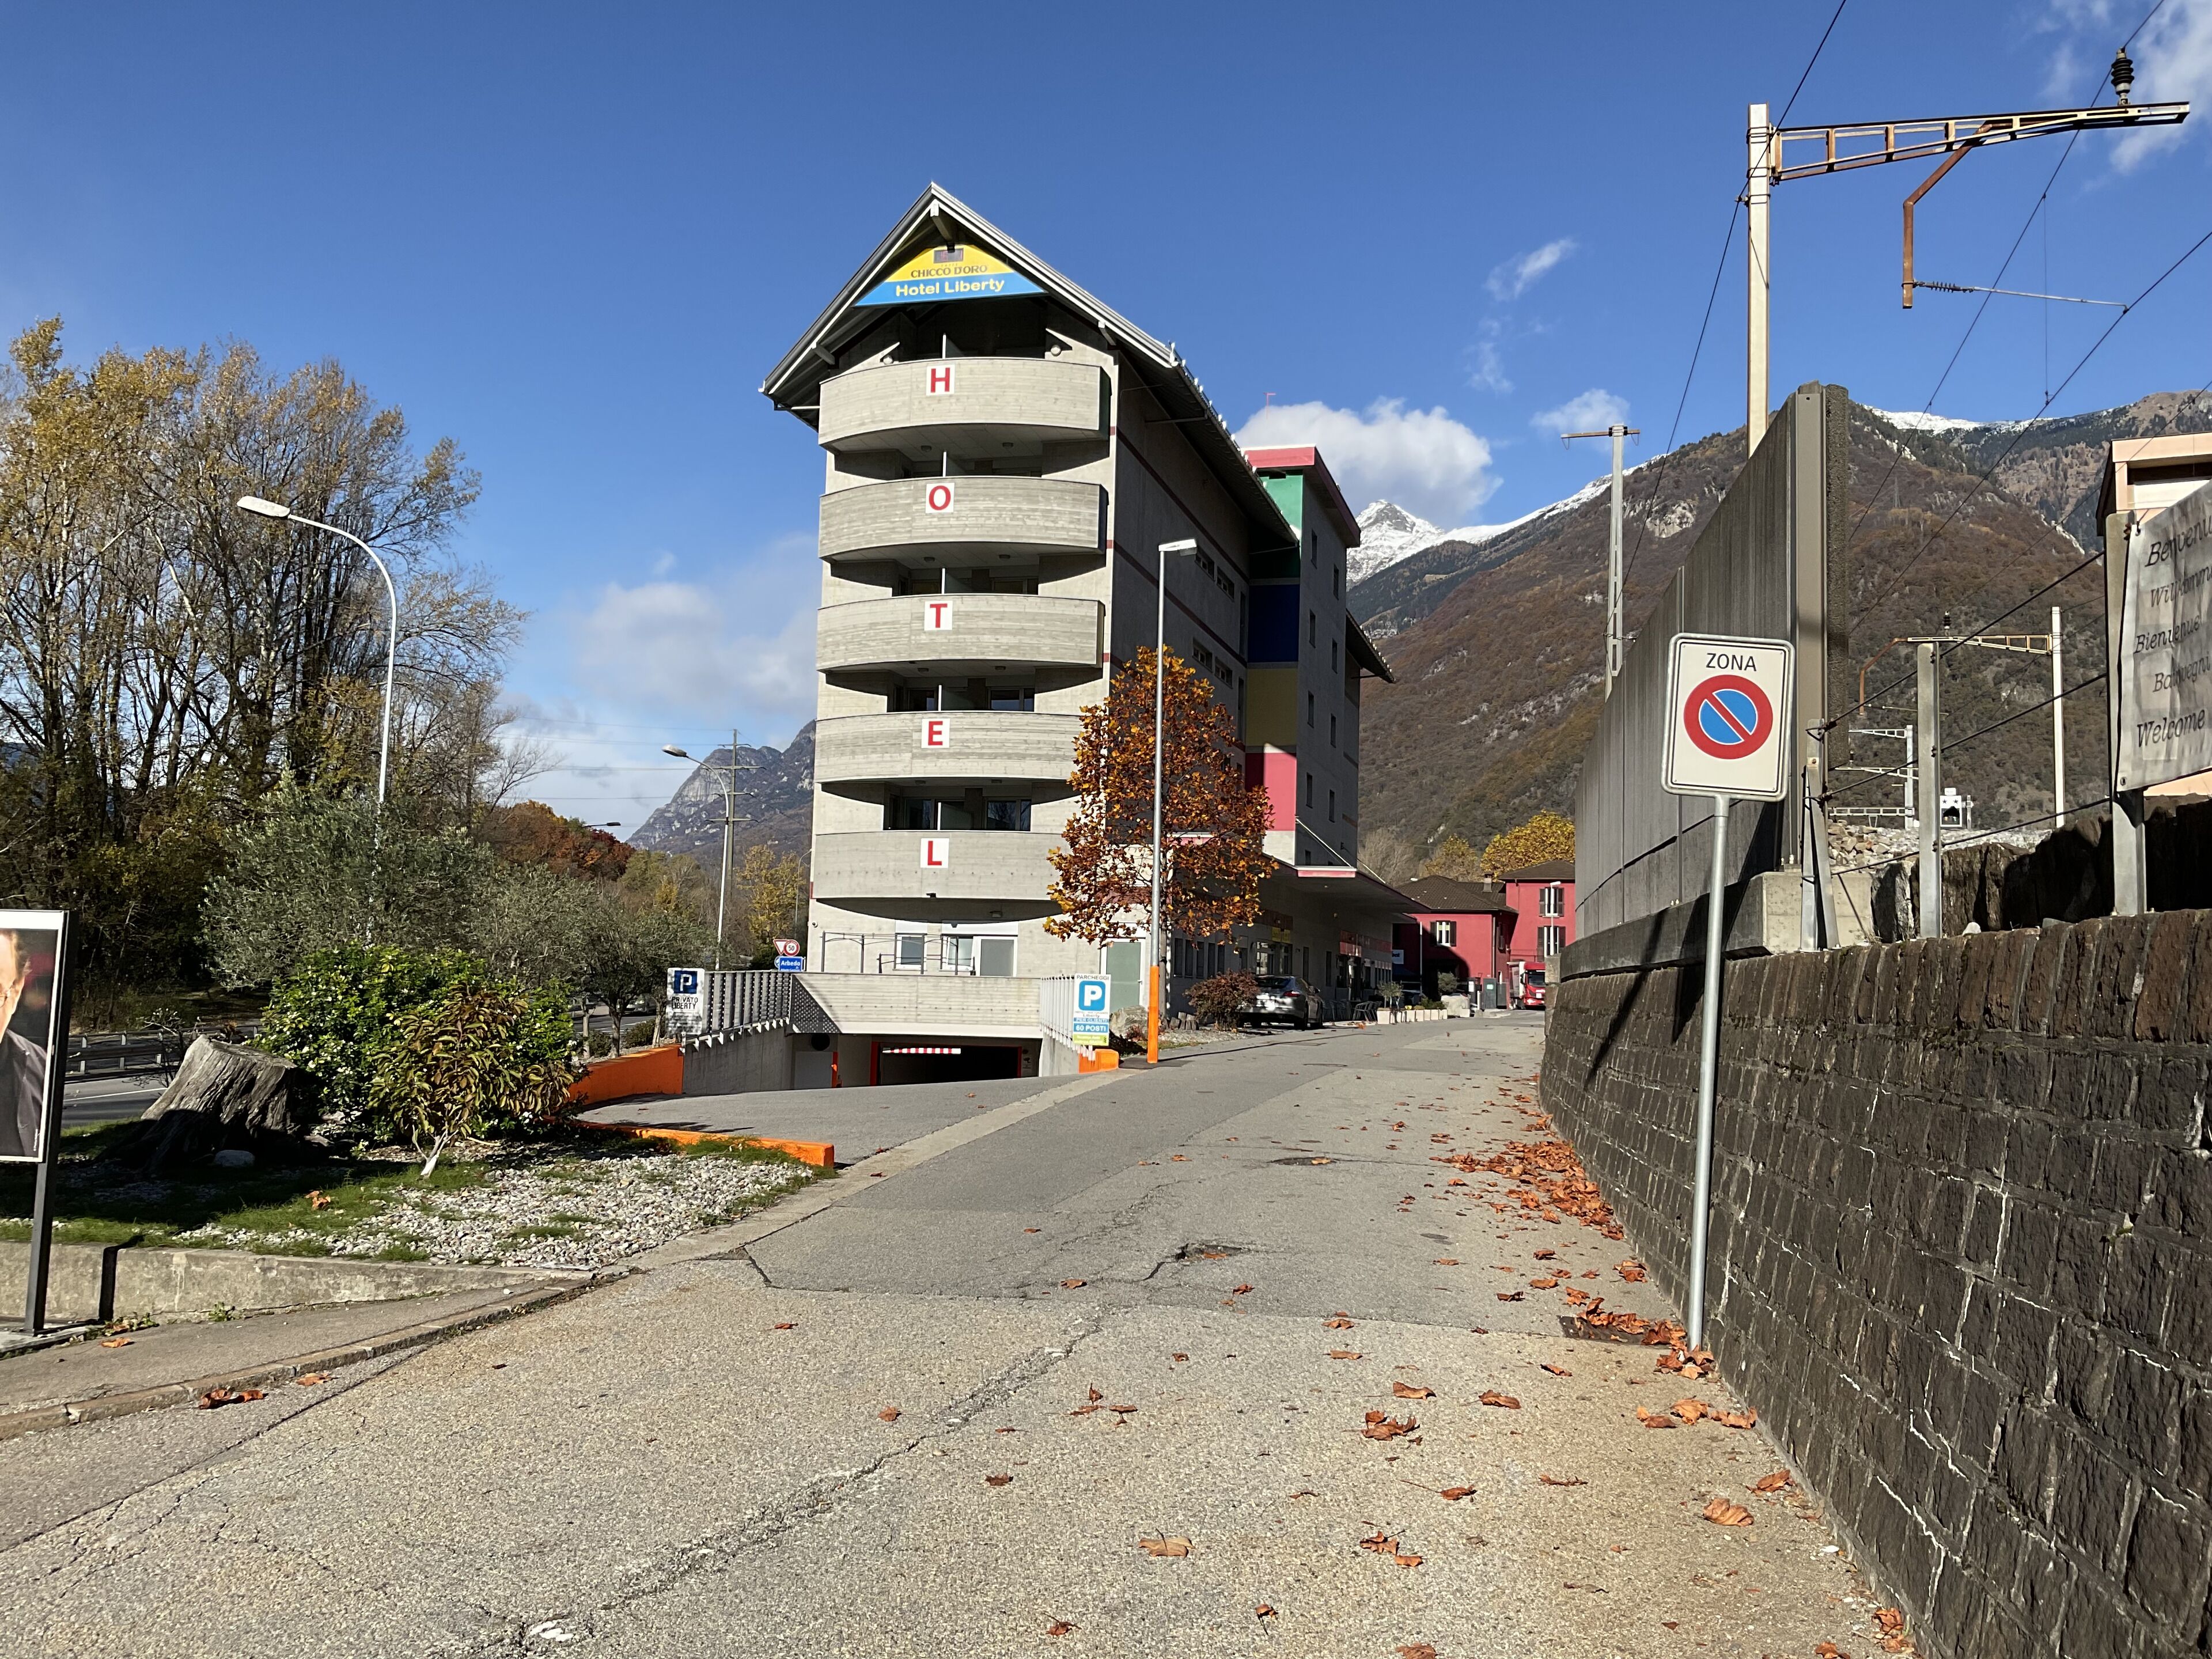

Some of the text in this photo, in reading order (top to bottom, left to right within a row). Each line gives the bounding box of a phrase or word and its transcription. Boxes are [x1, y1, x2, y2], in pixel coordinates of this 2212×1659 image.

[911, 267, 950, 278] CHICCO
[954, 264, 987, 275] D'ORO
[896, 278, 1005, 297] Hotel Liberty
[2150, 566, 2212, 608] Willkomm
[2133, 615, 2201, 654] Bienvenue
[1706, 653, 1757, 672] ZONA
[2137, 709, 2206, 748] Welcome
[680, 974, 692, 991] P
[1084, 984, 1103, 1007] P
